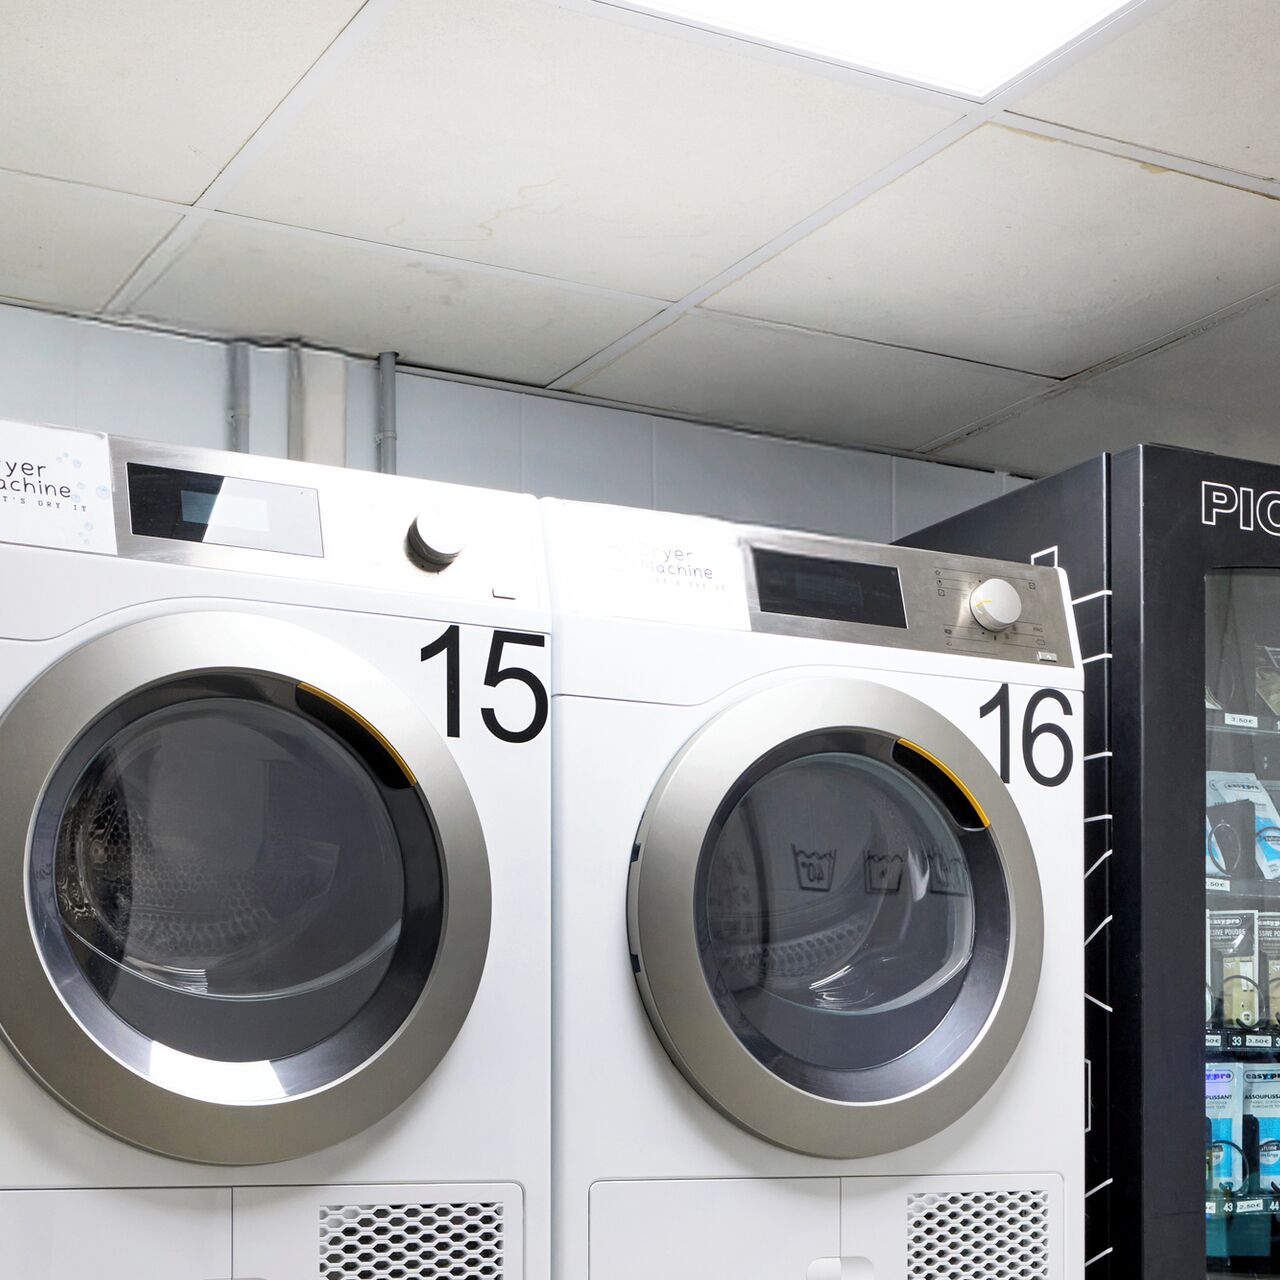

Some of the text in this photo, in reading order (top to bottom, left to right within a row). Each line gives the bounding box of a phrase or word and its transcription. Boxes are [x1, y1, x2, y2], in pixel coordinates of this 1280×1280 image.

[38, 499, 61, 510] DRY
[73, 504, 88, 512] IT
[642, 561, 713, 580] achine
[420, 625, 549, 744] 15
[979, 683, 1073, 787] 16
[1231, 1036, 1242, 1046] 33
